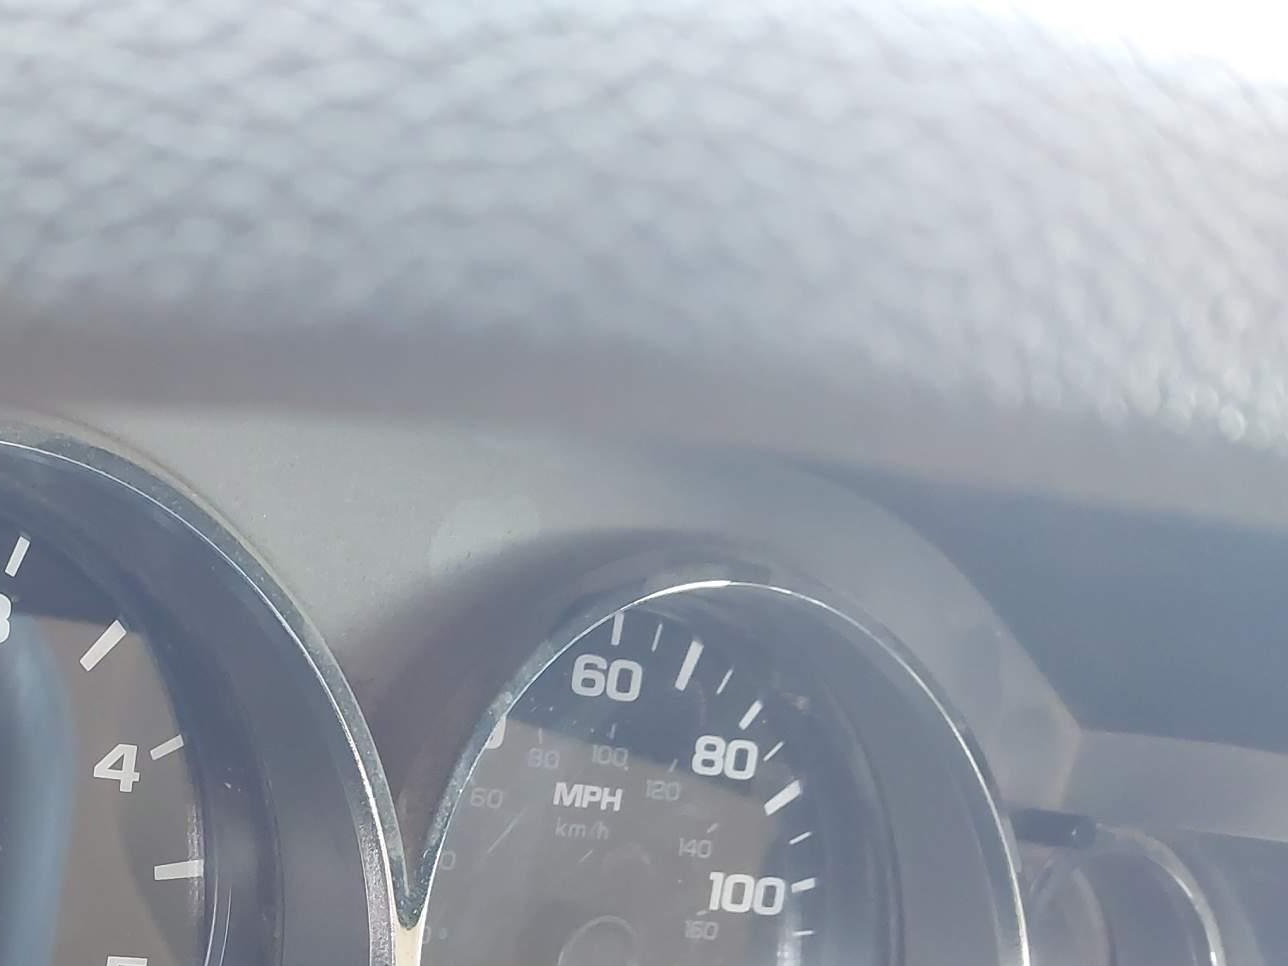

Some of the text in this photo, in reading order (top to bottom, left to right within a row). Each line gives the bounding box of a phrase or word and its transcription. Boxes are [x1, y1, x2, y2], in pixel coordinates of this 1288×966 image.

[571, 655, 643, 702] 60
[93, 743, 141, 792] 4
[591, 744, 629, 768] 100
[691, 735, 759, 780] 80
[470, 788, 503, 809] 60
[552, 782, 623, 811] MPH
[645, 779, 682, 801] 120
[554, 816, 610, 841] km/h
[678, 838, 712, 859] 140
[709, 871, 785, 916] 100
